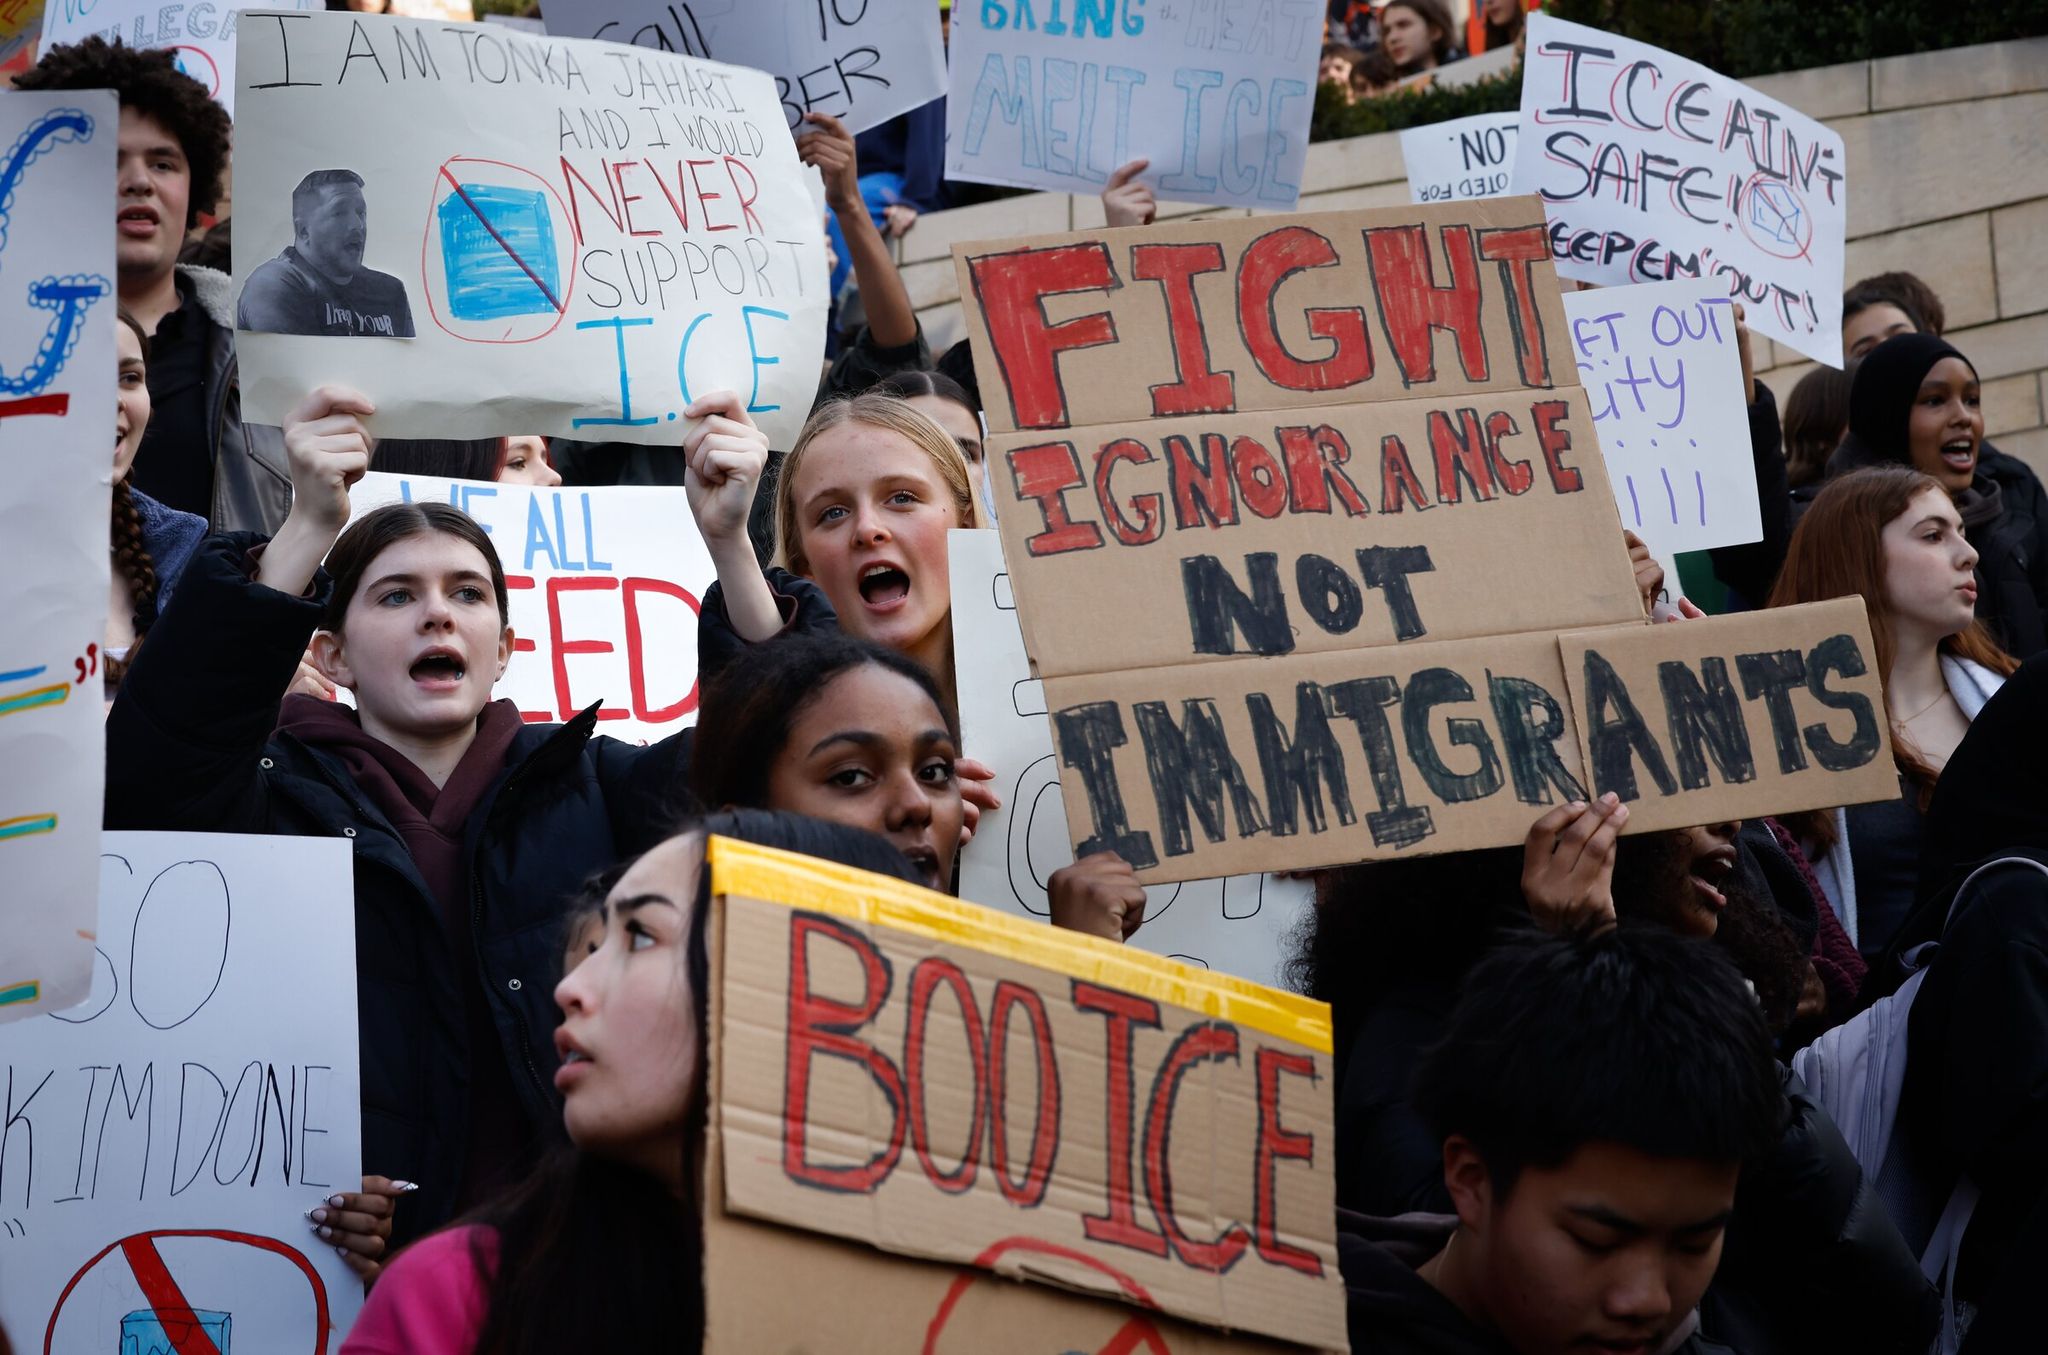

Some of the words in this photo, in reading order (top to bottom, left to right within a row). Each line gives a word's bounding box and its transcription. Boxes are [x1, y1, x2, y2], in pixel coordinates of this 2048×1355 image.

[245, 14, 323, 88] I
[338, 19, 442, 84] AM
[442, 27, 591, 96] TONKA
[603, 51, 745, 114] JAHARI
[1535, 40, 1715, 145] ICE
[559, 107, 631, 152] AND
[638, 106, 671, 148] I
[673, 112, 765, 159] WOULD
[962, 53, 1147, 184] MELT
[1159, 68, 1308, 200] ICE
[559, 155, 767, 246] NEVER
[582, 237, 808, 311] SUPPORT
[966, 221, 1555, 431] FIGHT
[1651, 298, 1733, 346] OUT
[523, 491, 613, 571] ALL
[1007, 401, 1584, 558] IGNORANCE
[1180, 544, 1437, 658] NOT
[1054, 634, 1882, 870] IMMIGRANTS
[171, 1060, 333, 1198] DONE
[782, 909, 1062, 1208] BOO
[1071, 977, 1328, 1279] ICE
